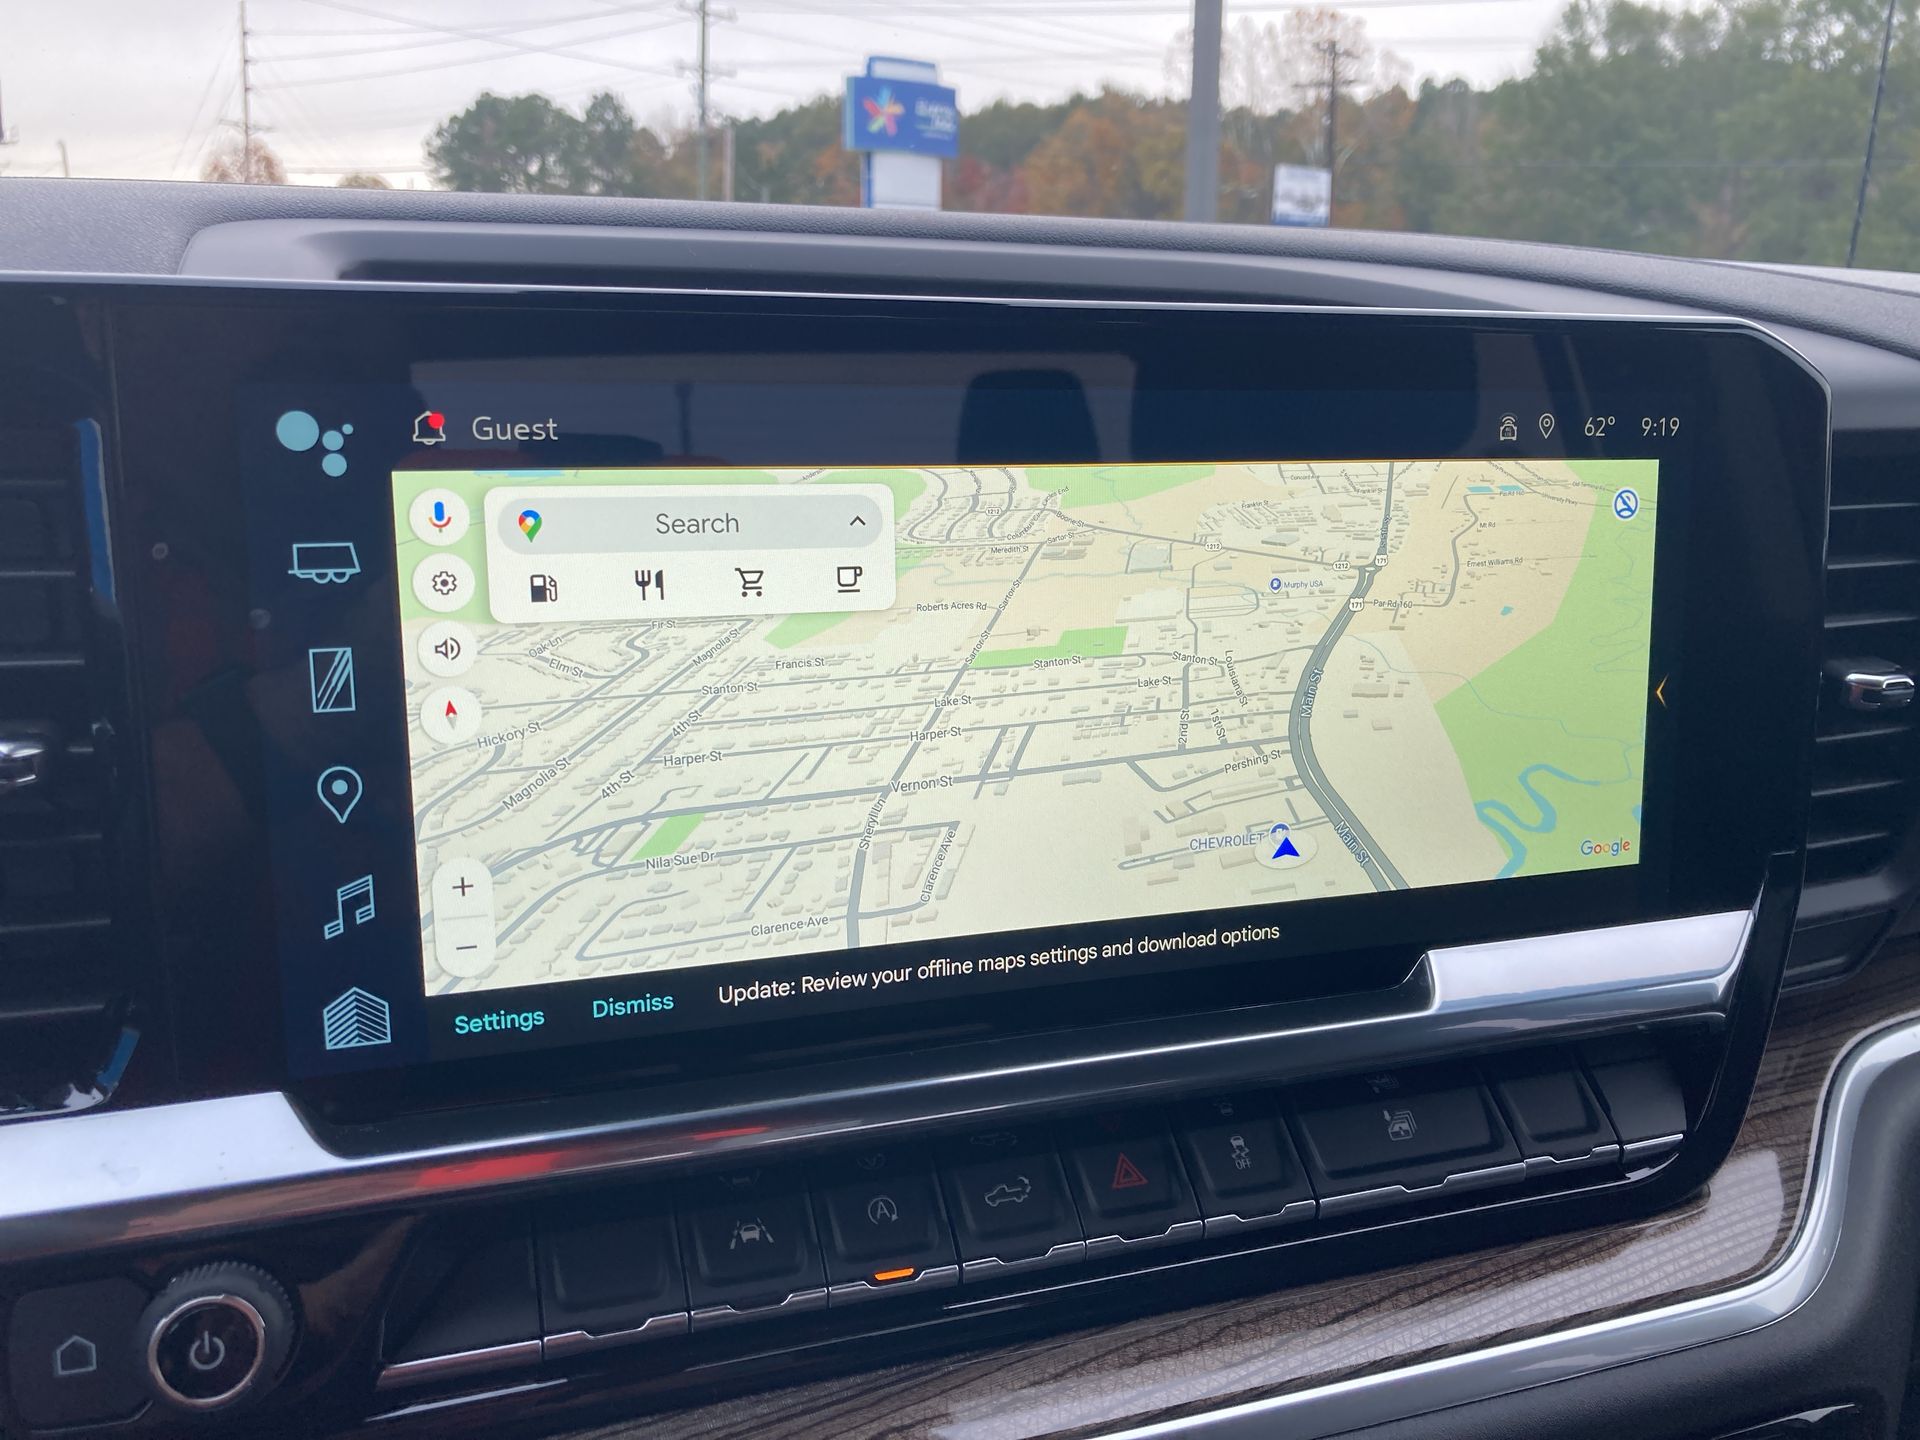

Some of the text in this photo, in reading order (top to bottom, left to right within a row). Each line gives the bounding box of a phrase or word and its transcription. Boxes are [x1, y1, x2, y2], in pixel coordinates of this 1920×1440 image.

[472, 416, 559, 441] Guest
[1641, 416, 1680, 437] 9:19
[655, 513, 740, 535] Search
[990, 544, 1029, 554] Meredith St
[1334, 562, 1348, 570] 1212
[1376, 557, 1387, 565] 171
[1487, 558, 1513, 567] Williams
[998, 578, 1022, 611] Sartor St
[1284, 580, 1324, 590] Murphy USA
[916, 601, 987, 612] Roberts Acres Rd
[1350, 601, 1363, 609] 171
[1373, 600, 1413, 609] Par Rd 160
[651, 619, 676, 630] Fir St
[528, 635, 563, 659] Oak Ln
[692, 628, 741, 667] Magnolia St
[965, 629, 991, 665] Sartor St
[549, 658, 584, 678] Elm St
[775, 657, 825, 670] Francis St
[1033, 655, 1082, 669] Stanton St
[1171, 651, 1218, 666] Stanton St
[701, 681, 758, 696] Stanton St
[1137, 676, 1172, 688] Lake St
[1224, 649, 1249, 708] Louisiana St
[934, 695, 972, 708] Lake St
[1301, 667, 1325, 719] Main St
[671, 709, 703, 738] 4th St
[1178, 709, 1190, 745] 2nd St
[1210, 707, 1227, 741] 1st St
[477, 721, 543, 749] Hickory St
[910, 727, 962, 743] Harper St
[663, 750, 723, 767] Harper St
[1224, 749, 1282, 774] Pershing St
[502, 756, 571, 811] Magnolia St
[600, 769, 636, 800] 4th St
[891, 775, 953, 793] Vernon St
[858, 798, 886, 851] Sheryl Ln
[1189, 832, 1265, 852] CHEVROLET
[1334, 820, 1370, 867] Main St
[1580, 837, 1631, 857] Google
[645, 851, 715, 869] Nila Sue Dr
[920, 829, 957, 903] Clarence Ave
[750, 916, 829, 937] Clarence Ave
[718, 923, 1281, 1006] Update: Review your offline maps settings and download options
[592, 992, 675, 1019] Dismiss
[454, 1008, 545, 1035] Settings
